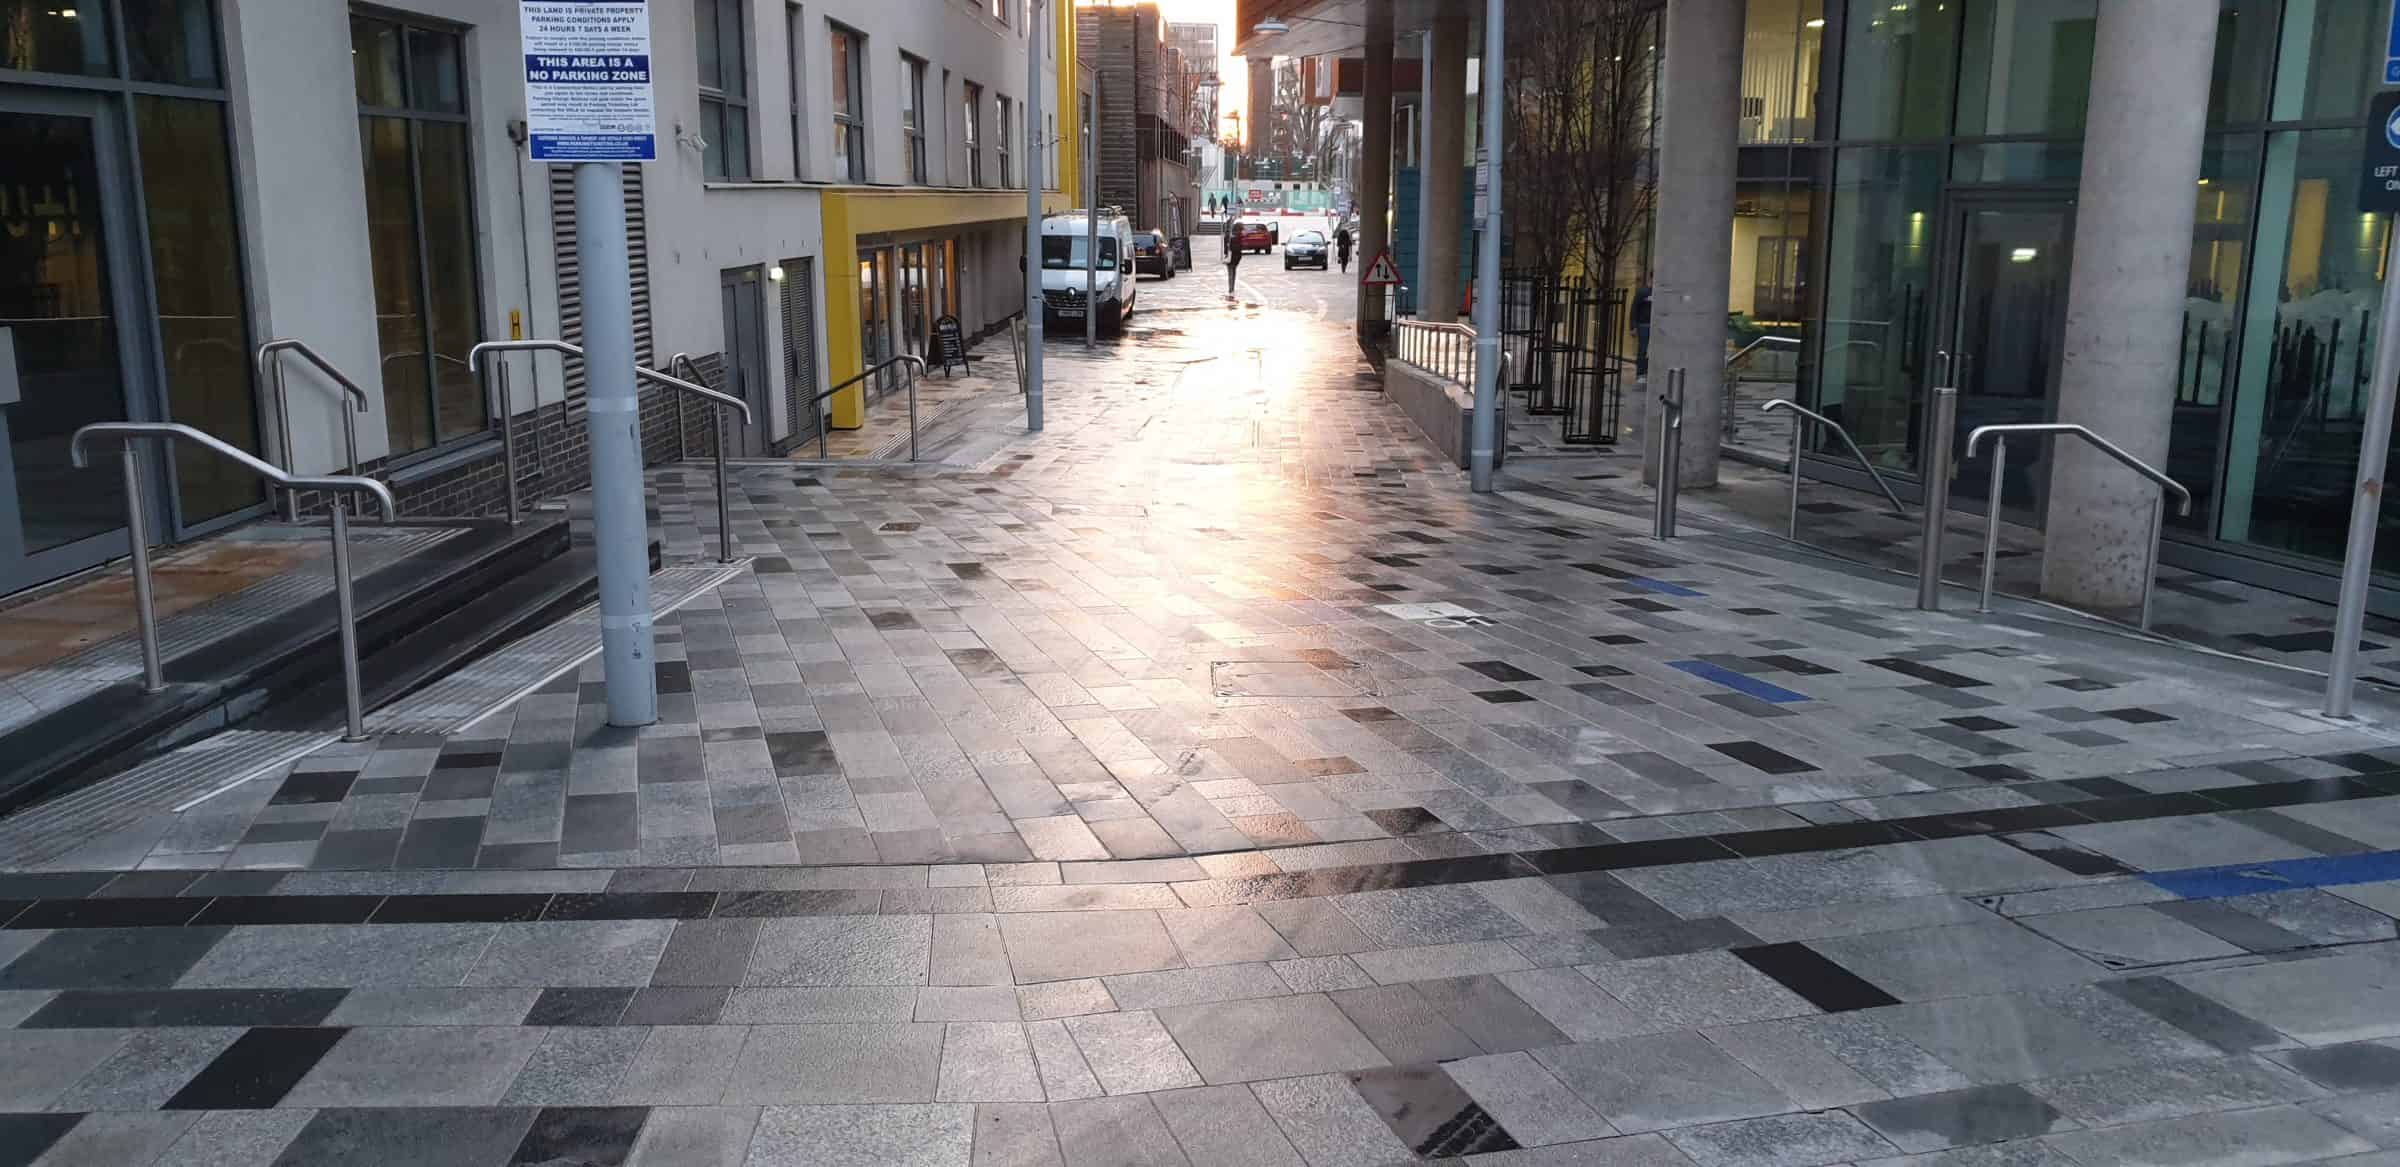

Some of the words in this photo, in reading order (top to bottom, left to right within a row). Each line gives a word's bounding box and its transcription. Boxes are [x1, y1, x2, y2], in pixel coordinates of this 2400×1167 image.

[537, 57, 568, 67] THIS
[571, 57, 606, 67] AREA
[608, 57, 621, 67] IS
[624, 57, 634, 67] A
[529, 70, 549, 80] NO
[552, 70, 609, 81] PARKING
[611, 71, 647, 81] ZONE
[2374, 166, 2399, 177] LEFT
